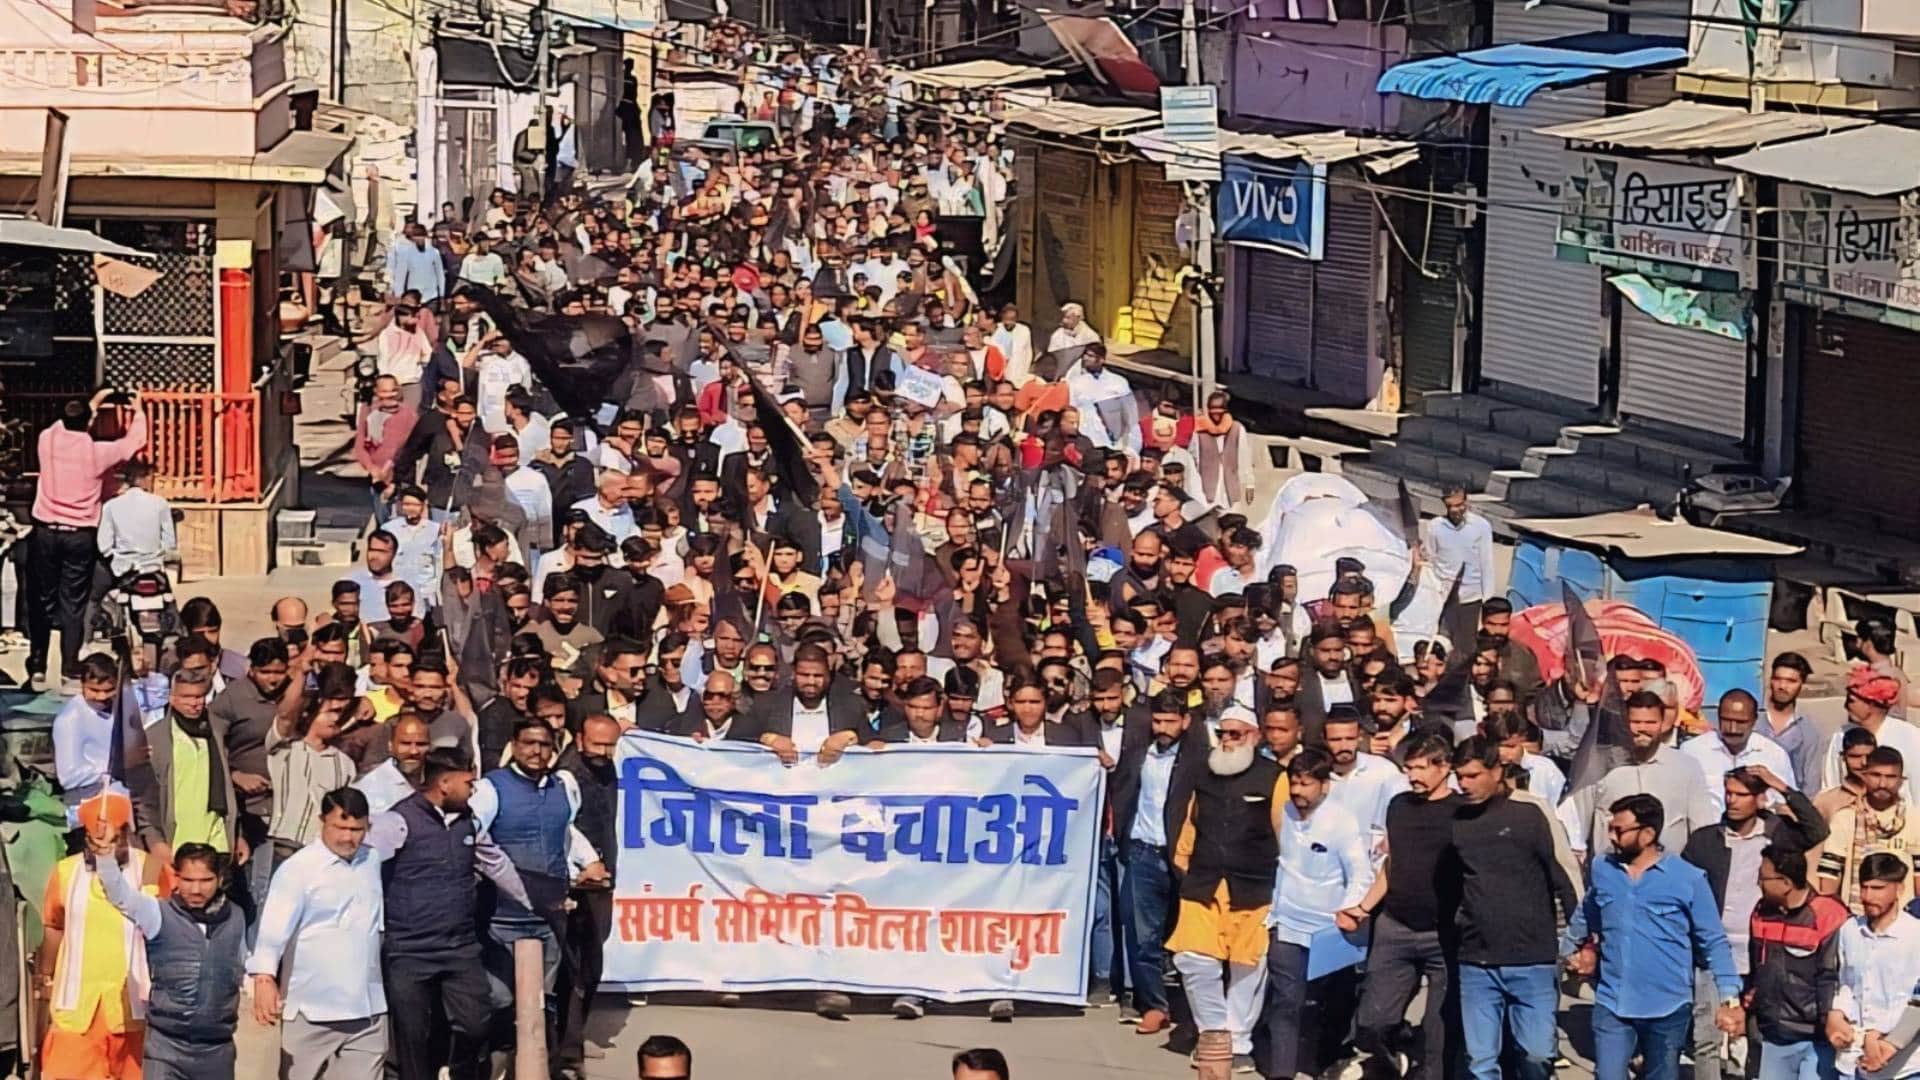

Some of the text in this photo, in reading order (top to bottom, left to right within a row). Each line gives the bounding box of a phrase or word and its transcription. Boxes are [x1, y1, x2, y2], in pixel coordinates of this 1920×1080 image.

[1621, 172, 1731, 230] डिसाइड
[617, 757, 1079, 865] जिला बचाओ
[615, 884, 1067, 971] संघर्ष समिति जिला शाहपुरा
